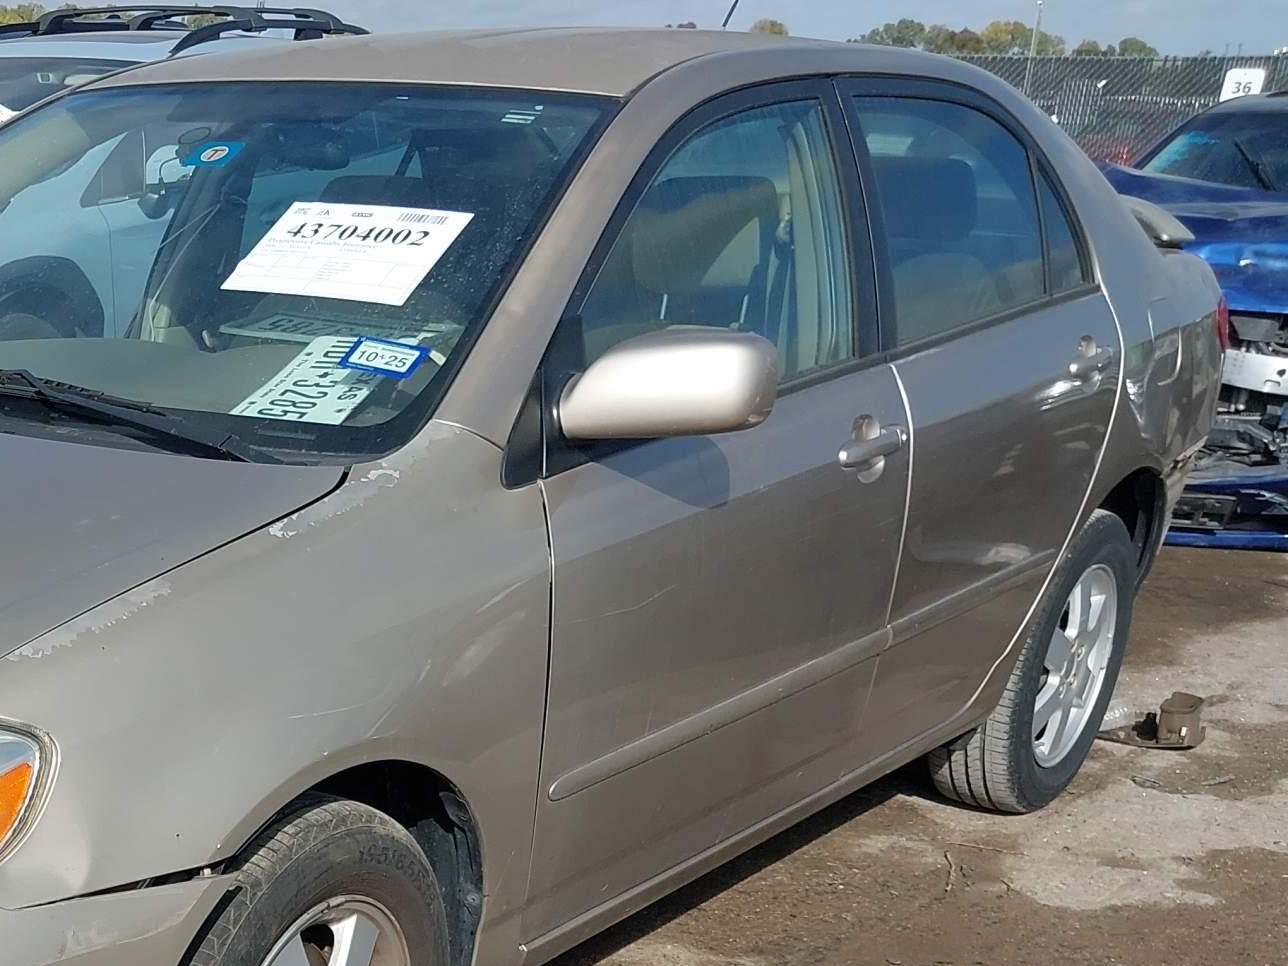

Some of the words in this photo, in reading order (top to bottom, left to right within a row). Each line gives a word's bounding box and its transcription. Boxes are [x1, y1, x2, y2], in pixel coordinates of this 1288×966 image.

[1231, 81, 1253, 94] 36
[286, 221, 431, 247] 43704002
[357, 349, 379, 363] 10
[383, 354, 410, 369] 25
